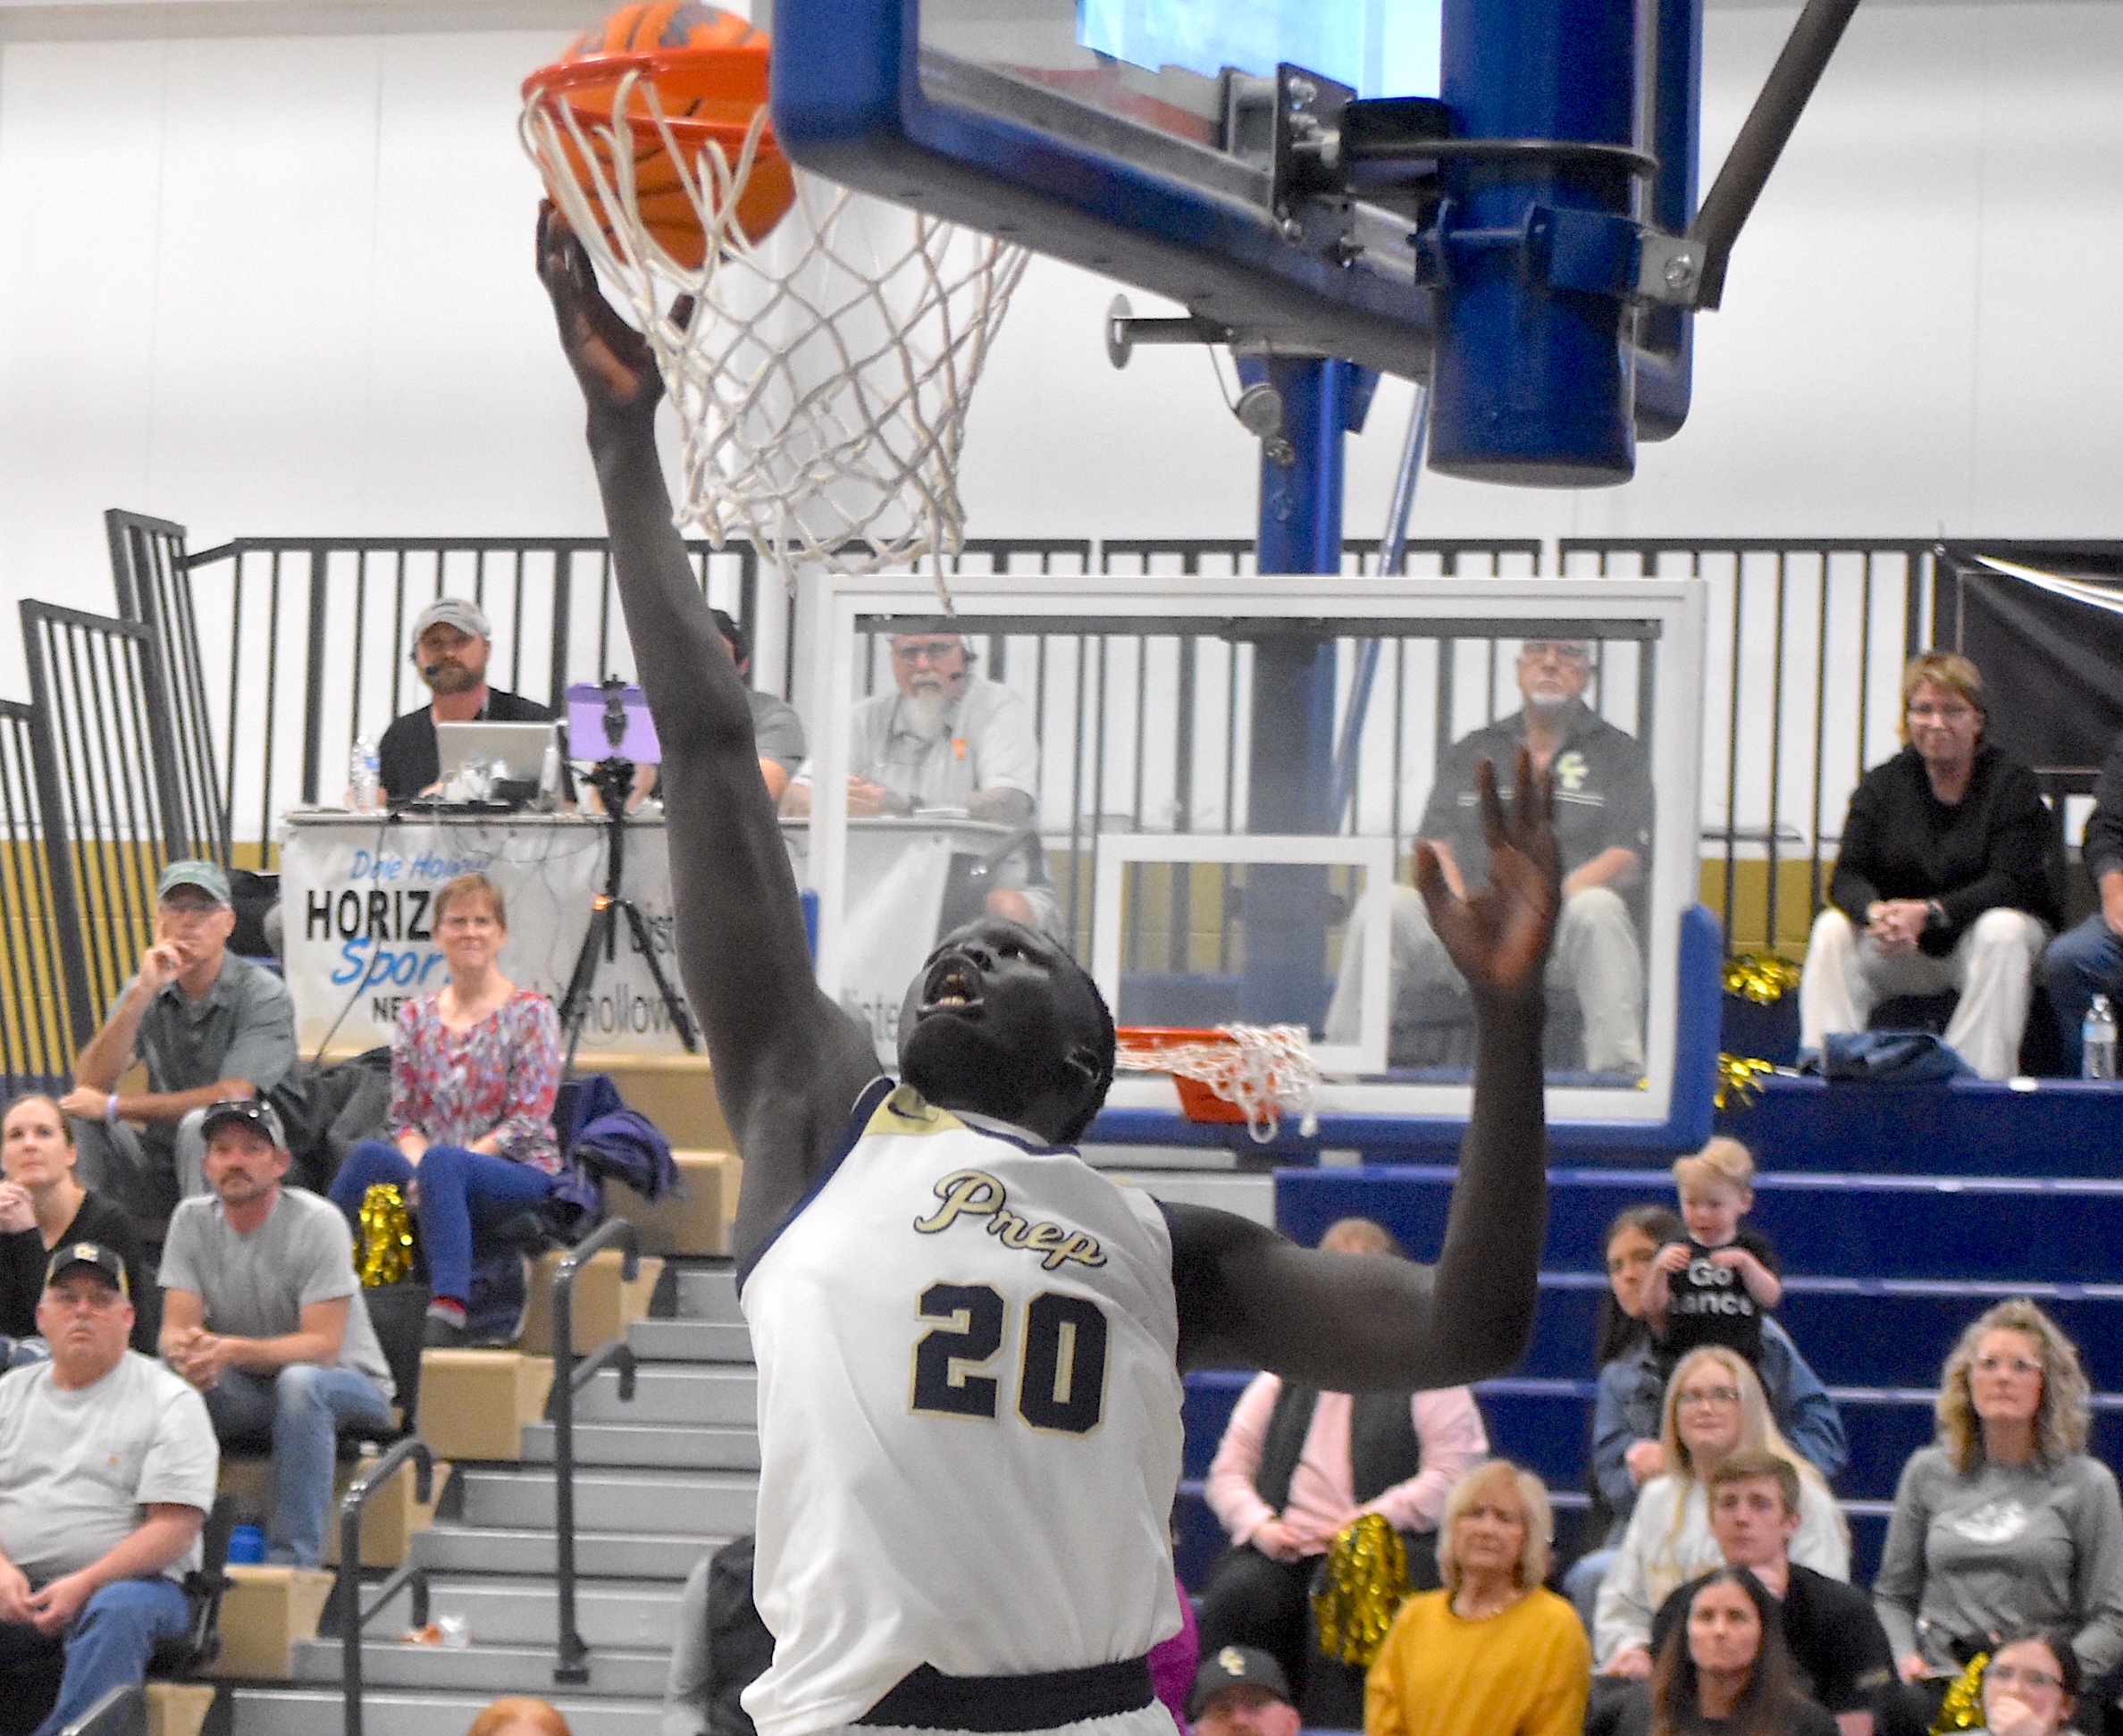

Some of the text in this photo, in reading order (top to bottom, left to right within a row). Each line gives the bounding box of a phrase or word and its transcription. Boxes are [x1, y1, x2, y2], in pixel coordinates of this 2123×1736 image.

[306, 890, 432, 941] HORIZ
[331, 935, 452, 999] Spor
[913, 1169, 1107, 1270] Prep
[1688, 1258, 1733, 1287] Go
[908, 1279, 1110, 1440] 20
